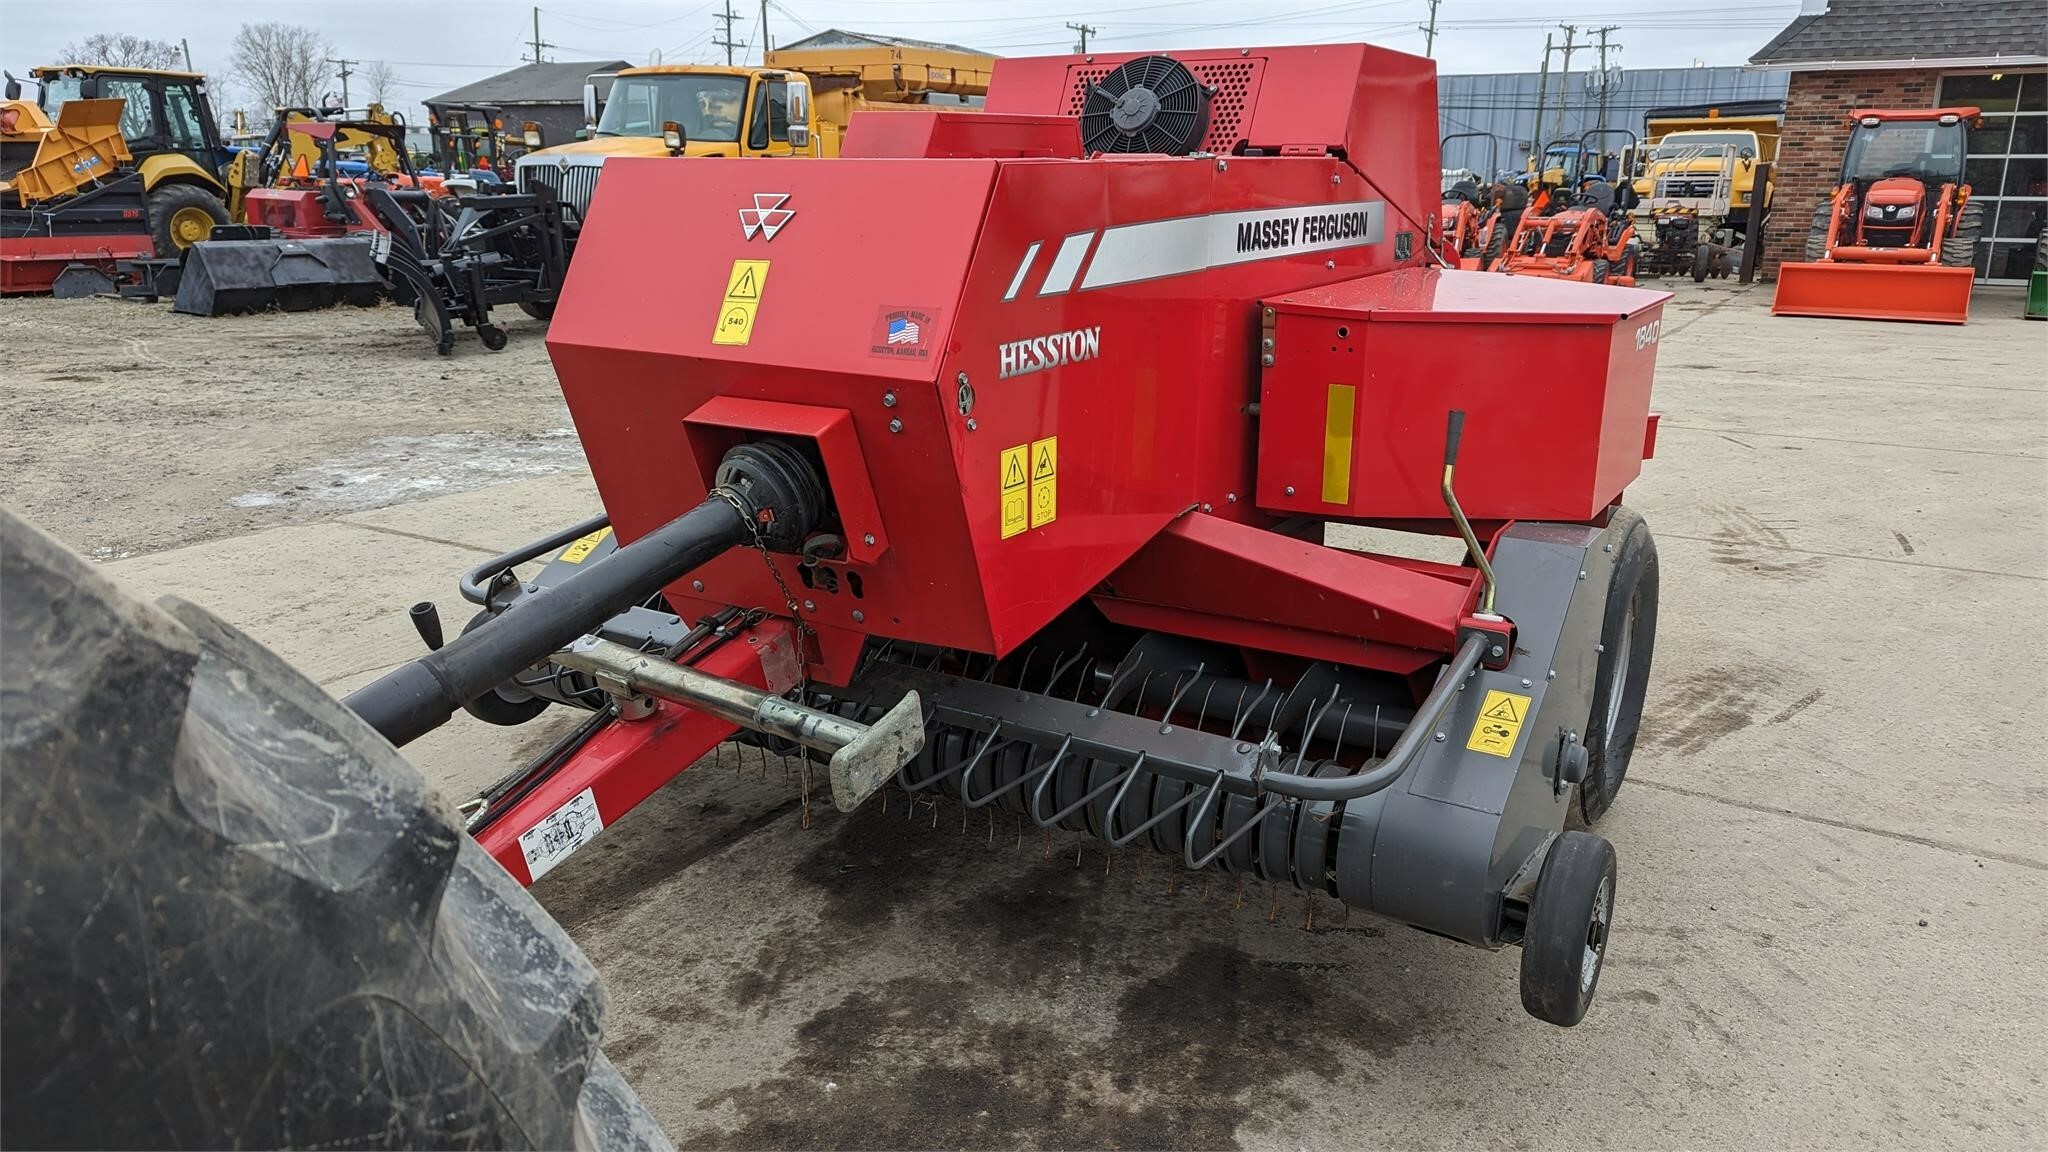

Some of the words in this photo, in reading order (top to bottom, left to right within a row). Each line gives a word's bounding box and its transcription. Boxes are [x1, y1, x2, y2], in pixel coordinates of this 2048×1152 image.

[766, 54, 776, 64] 74
[890, 49, 902, 60] 74
[1236, 217, 1299, 254] MASSEY
[1302, 211, 1368, 245] FERGUSON
[728, 317, 744, 325] 540
[1635, 320, 1660, 351] 1840
[999, 325, 1101, 379] HESSTON
[1037, 509, 1052, 521] STOP
